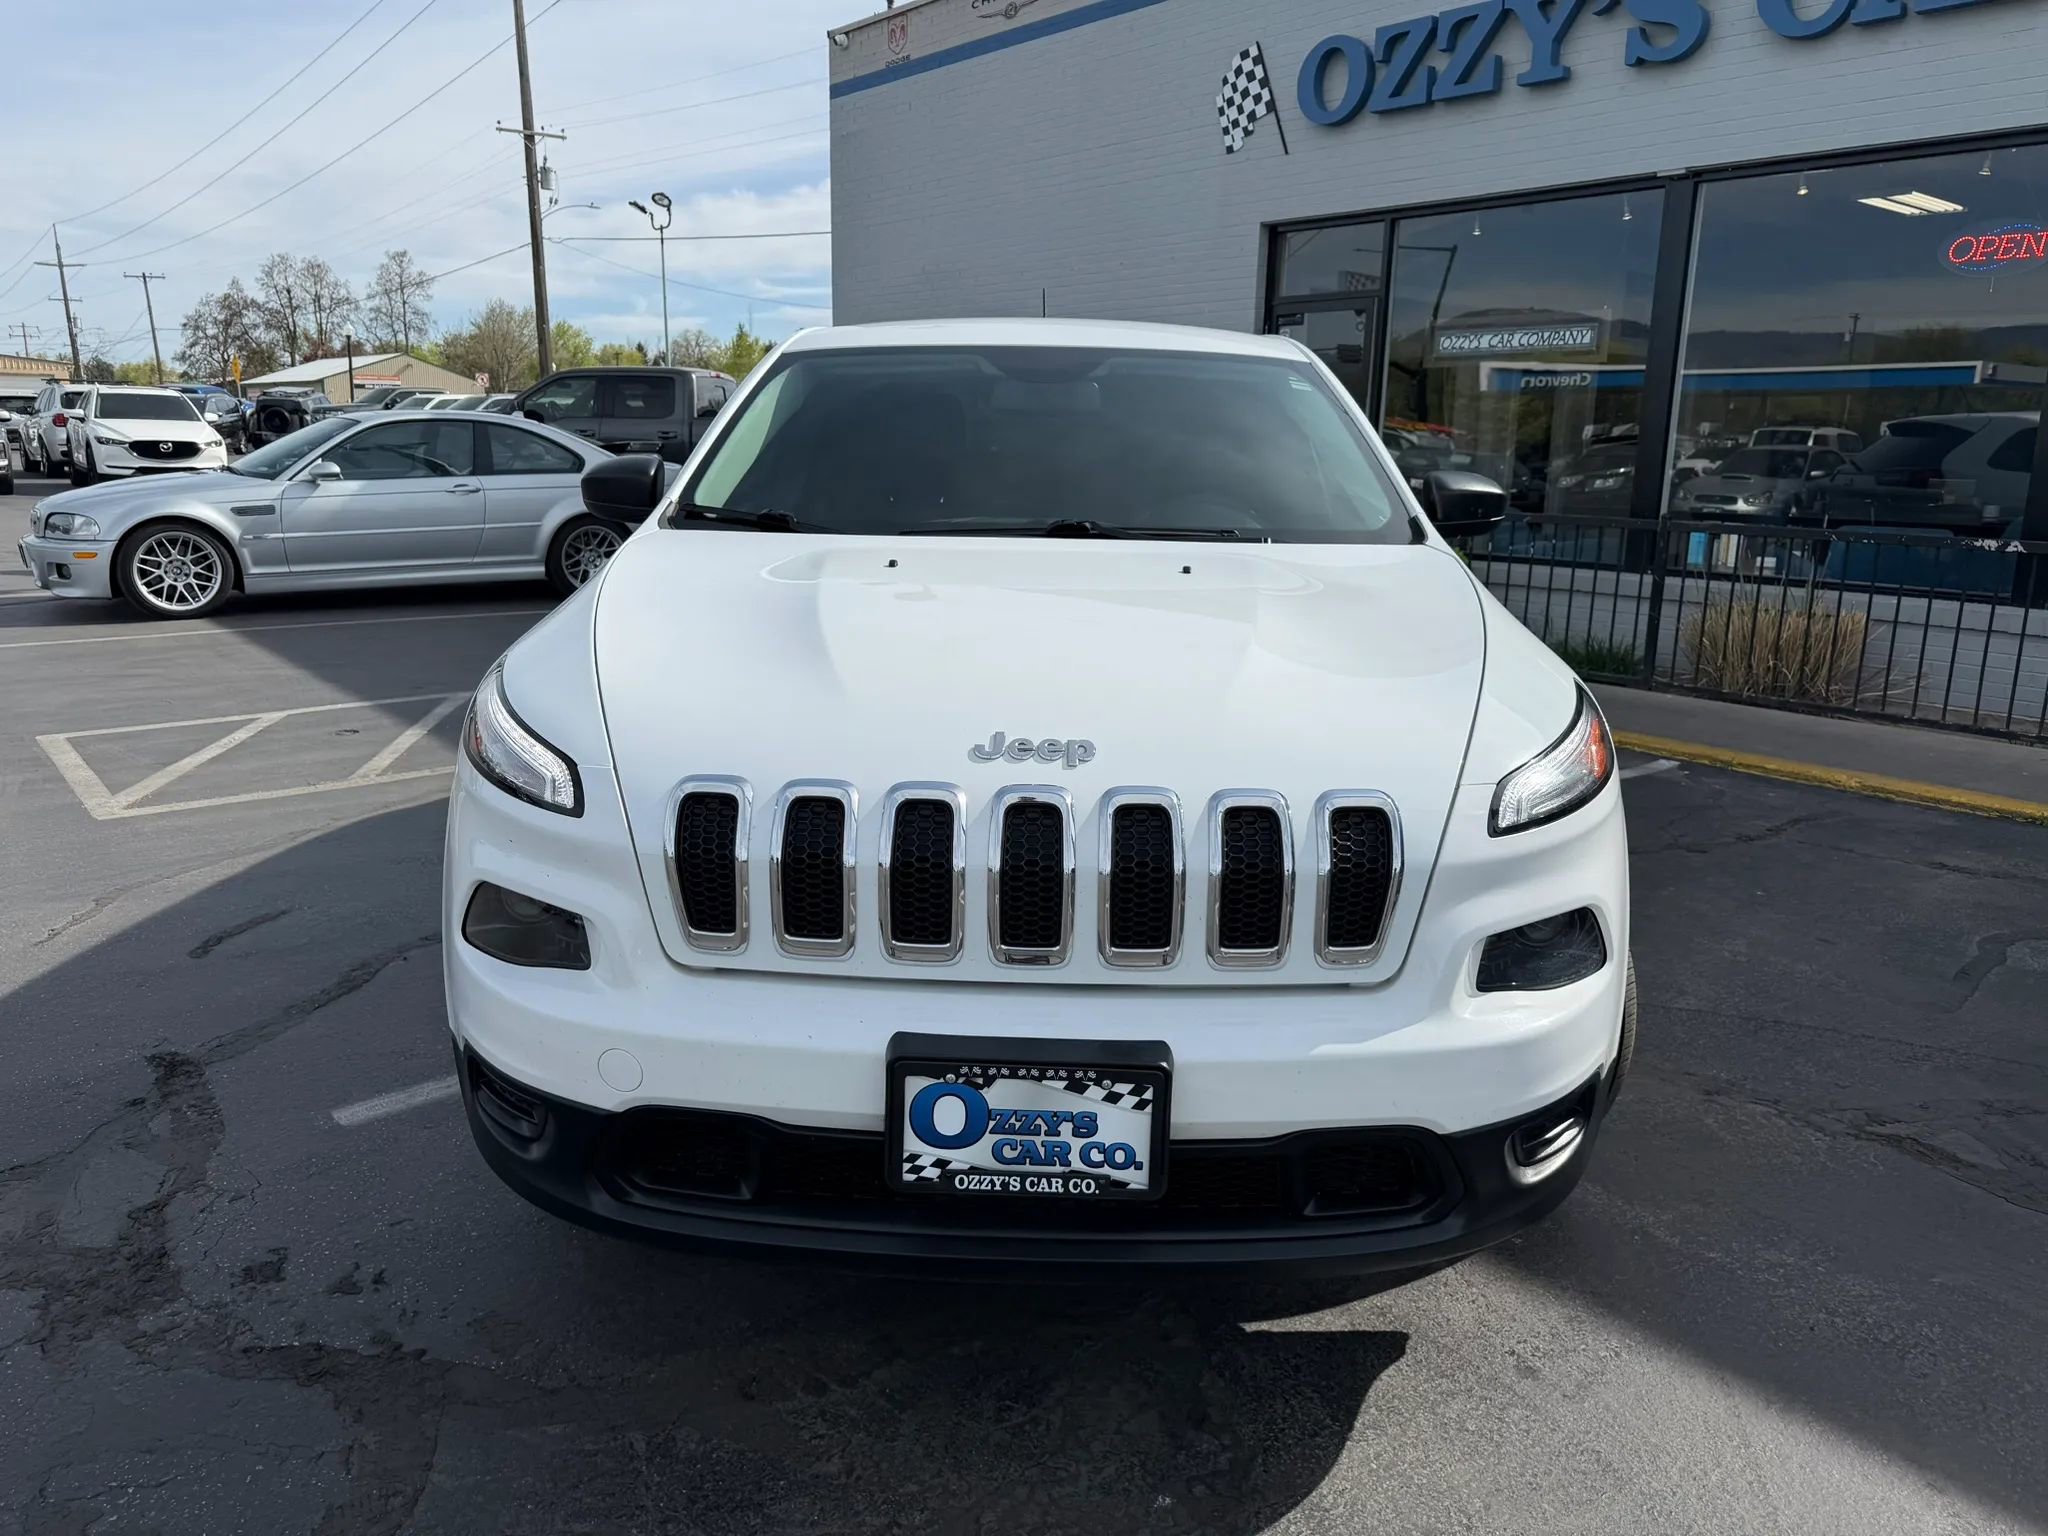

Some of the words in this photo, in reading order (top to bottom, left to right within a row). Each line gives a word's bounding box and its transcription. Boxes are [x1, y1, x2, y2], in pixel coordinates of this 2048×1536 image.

[885, 54, 911, 67] DODGE
[1948, 230, 2048, 263] OPEN
[1441, 334, 1482, 350] OZZY'S
[1488, 332, 1514, 349] CAR
[1518, 328, 1590, 347] COMPANY
[973, 731, 1096, 768] Jeep
[908, 1082, 1099, 1150] OZZY'S
[991, 1138, 1072, 1168] CAR
[1079, 1141, 1144, 1170] CO.
[954, 1174, 1021, 1192] OZZY'S
[1025, 1175, 1064, 1193] CAR
[1068, 1178, 1100, 1194] CO.
